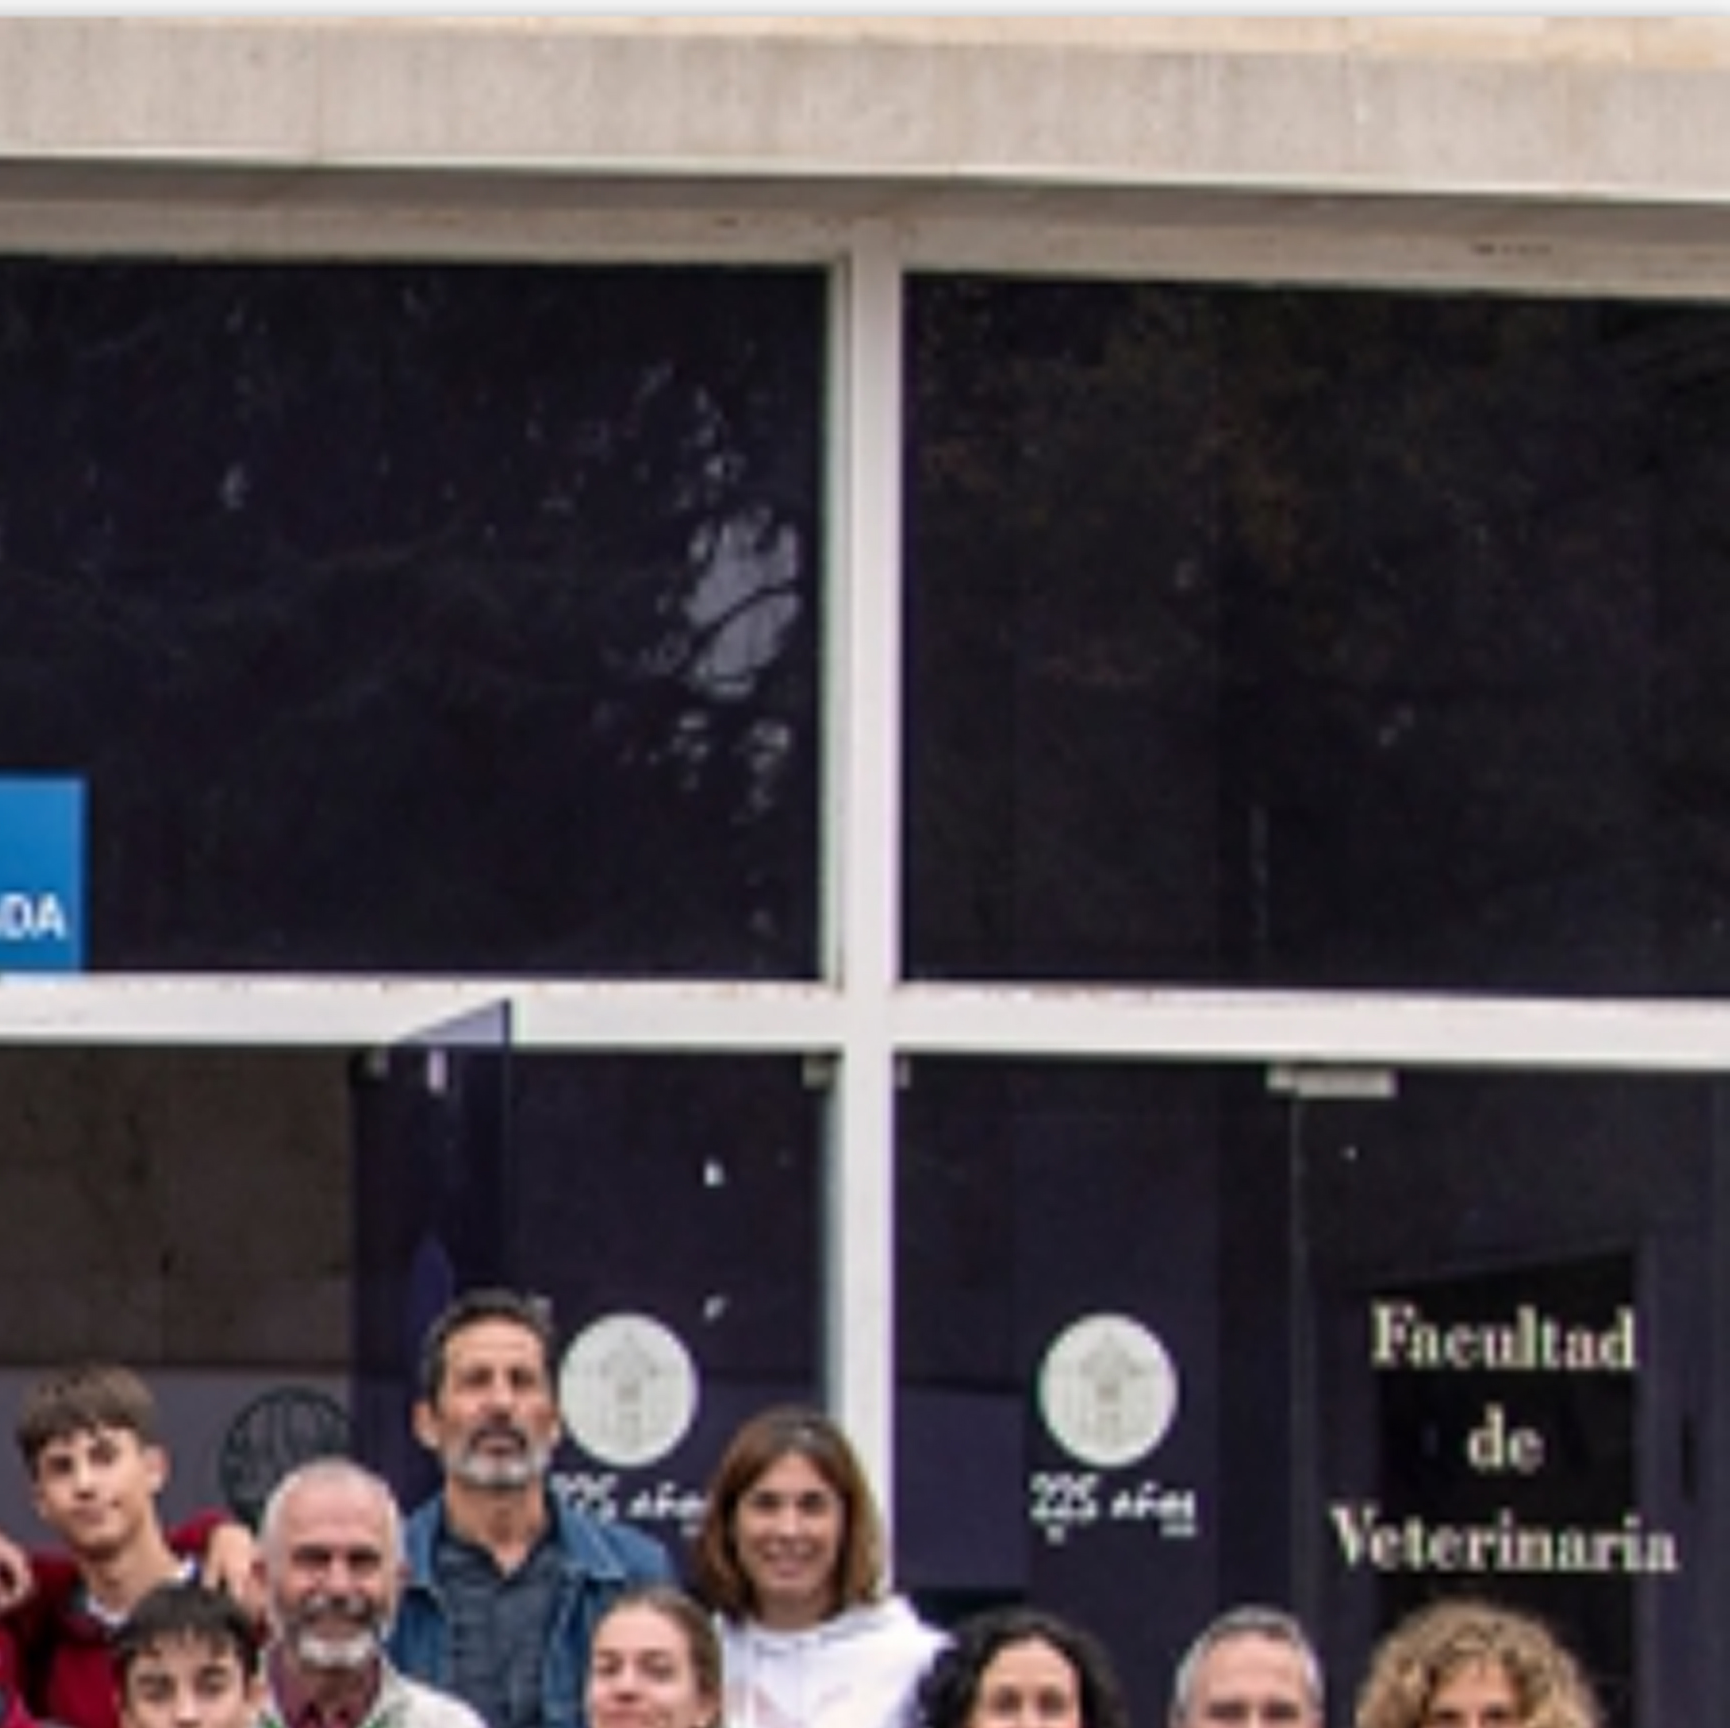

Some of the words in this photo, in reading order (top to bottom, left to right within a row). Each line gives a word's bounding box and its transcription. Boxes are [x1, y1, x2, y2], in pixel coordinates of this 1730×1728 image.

[1370, 1303, 1638, 1370] Facultad
[1465, 1402, 1545, 1472] de
[1328, 1504, 1680, 1571] Veterinaria
